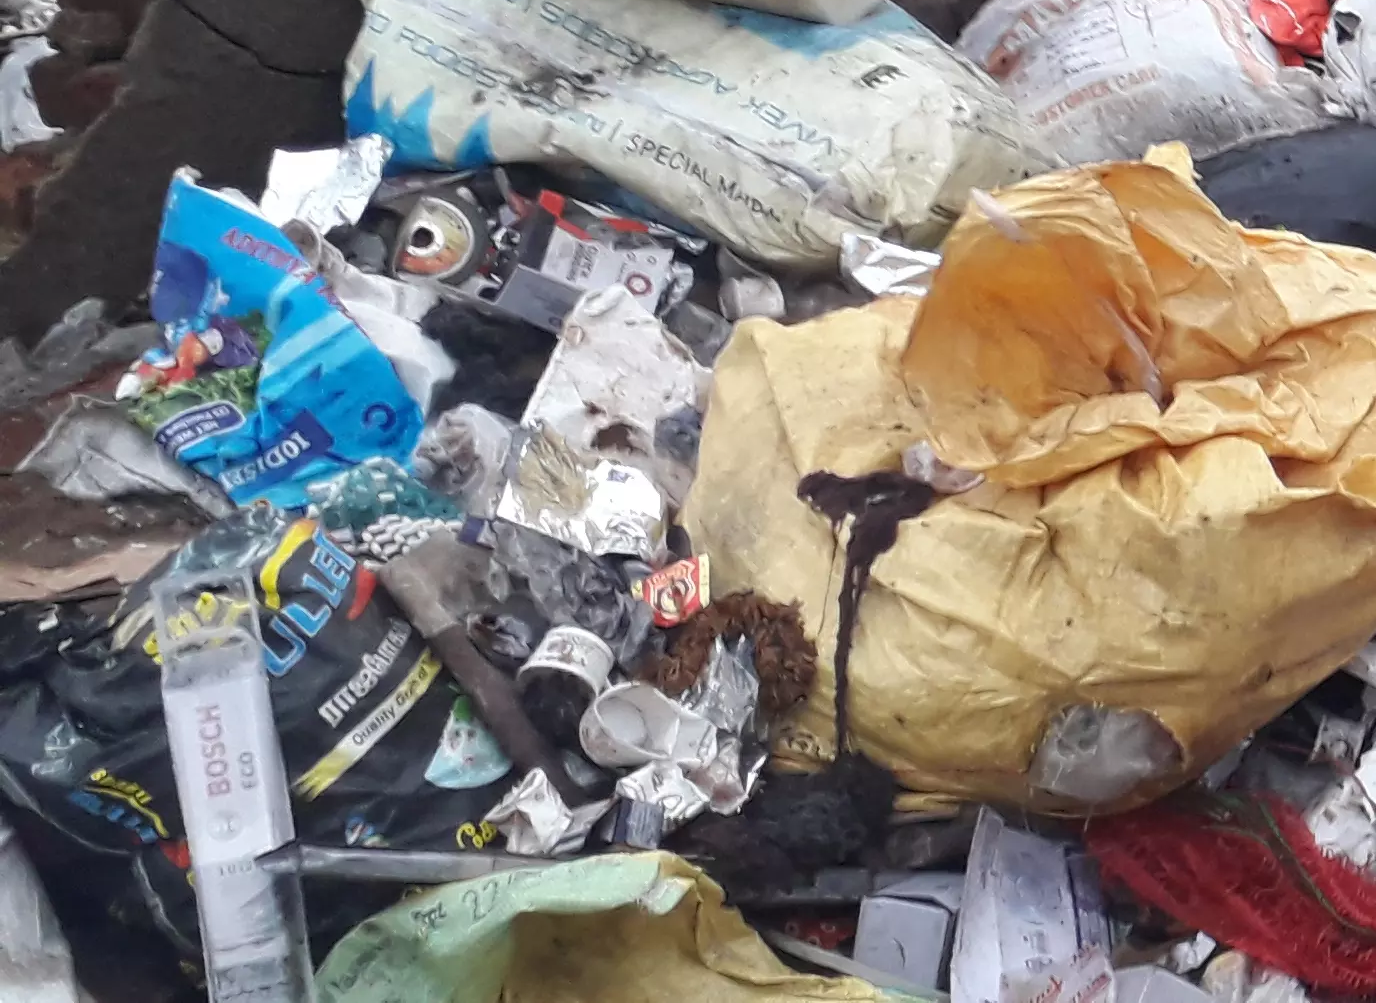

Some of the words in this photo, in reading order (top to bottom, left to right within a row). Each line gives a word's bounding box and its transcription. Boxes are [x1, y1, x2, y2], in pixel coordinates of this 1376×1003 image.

[626, 132, 712, 187] SPECIAL
[196, 703, 231, 798] BOSCH
[237, 750, 257, 792] ECO
